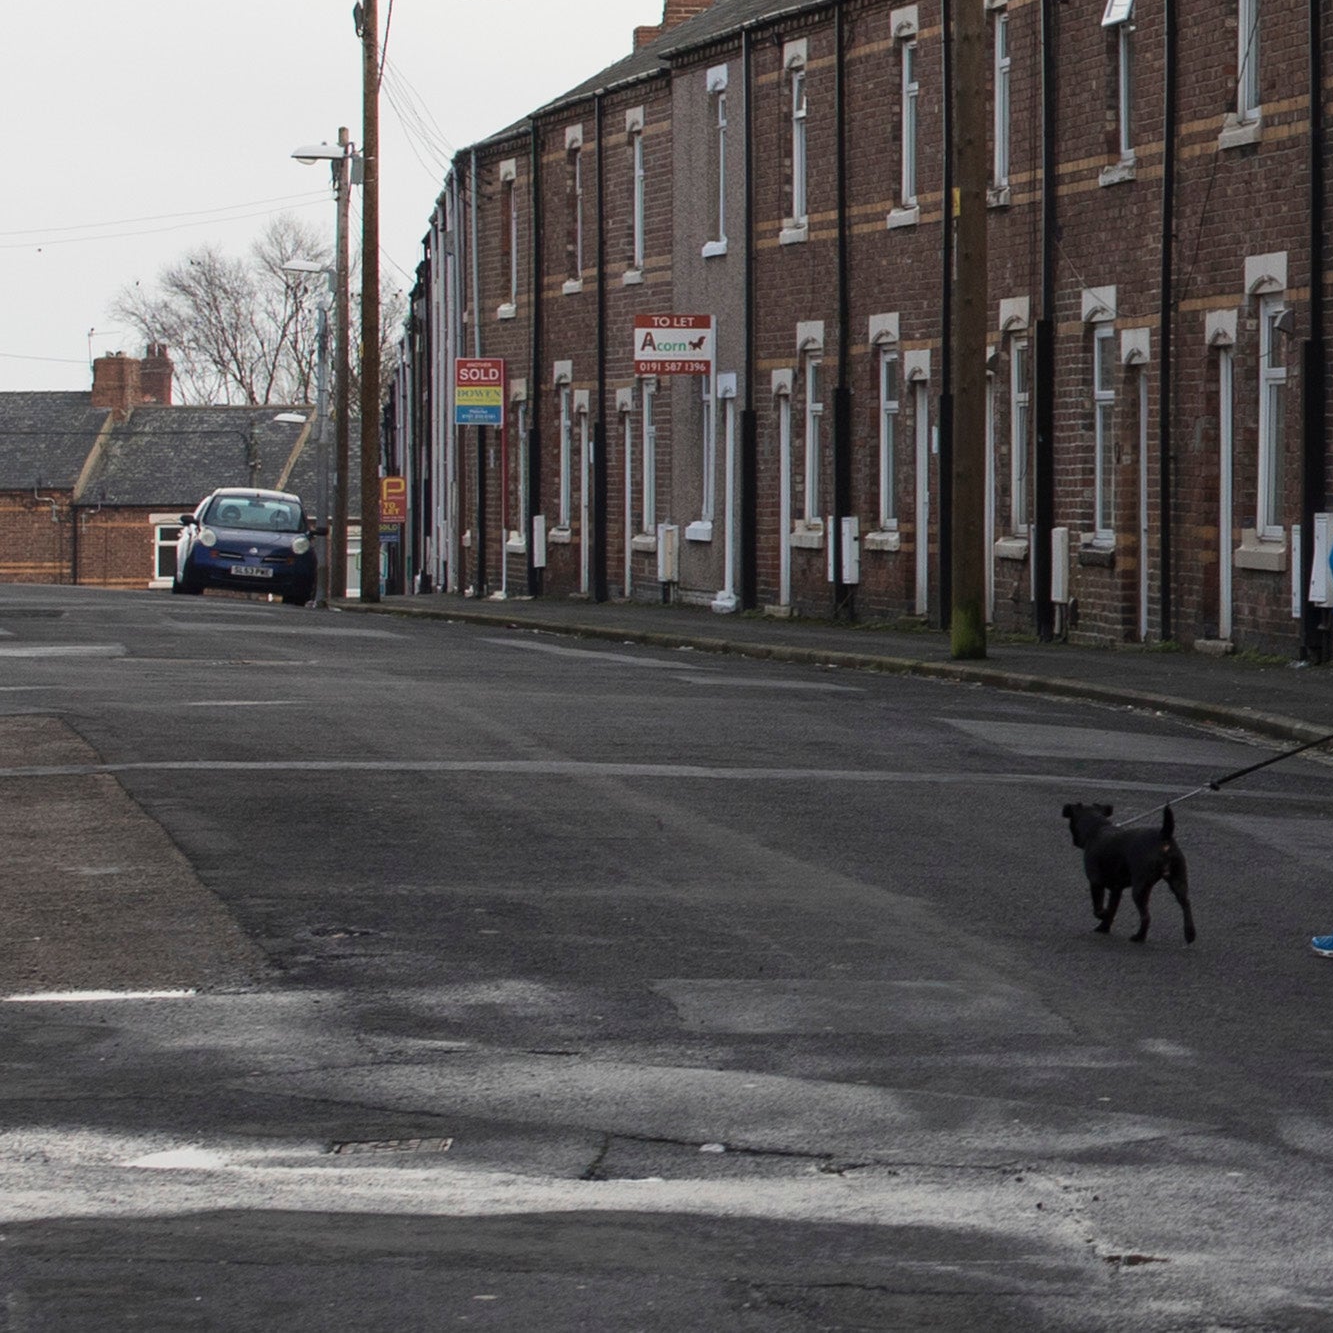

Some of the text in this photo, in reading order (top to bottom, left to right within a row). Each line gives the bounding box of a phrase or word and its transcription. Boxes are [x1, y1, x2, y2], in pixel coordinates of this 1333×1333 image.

[651, 316, 695, 327] TO LET
[640, 331, 686, 351] Acorn
[640, 362, 706, 371] 0191 587 1396
[459, 368, 499, 380] SOLD
[382, 477, 405, 500] P
